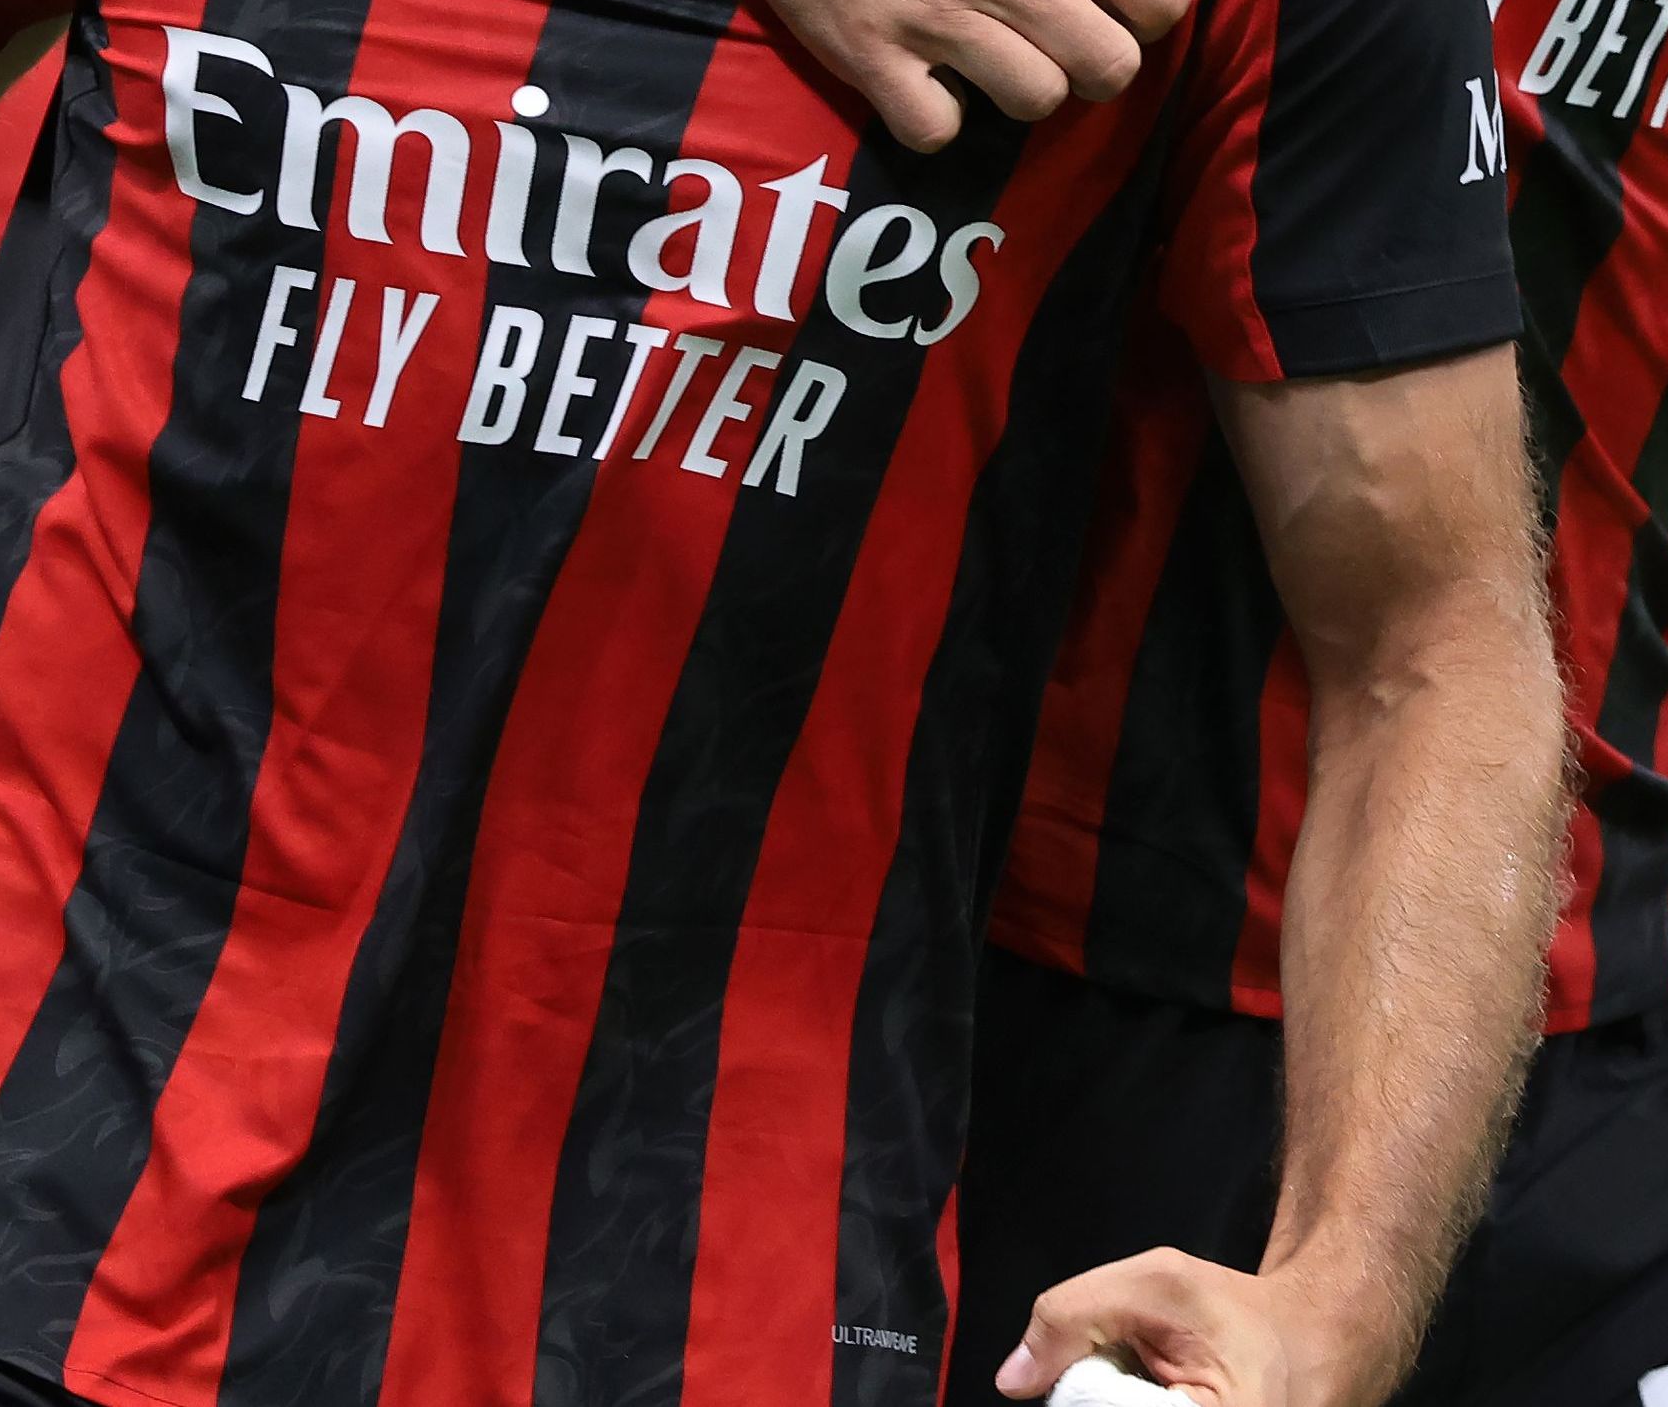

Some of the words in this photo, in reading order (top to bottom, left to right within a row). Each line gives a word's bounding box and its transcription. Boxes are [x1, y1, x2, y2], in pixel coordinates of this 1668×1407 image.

[161, 24, 1007, 347] Emirates
[241, 264, 441, 429] FLY
[456, 303, 847, 498] BETTER
